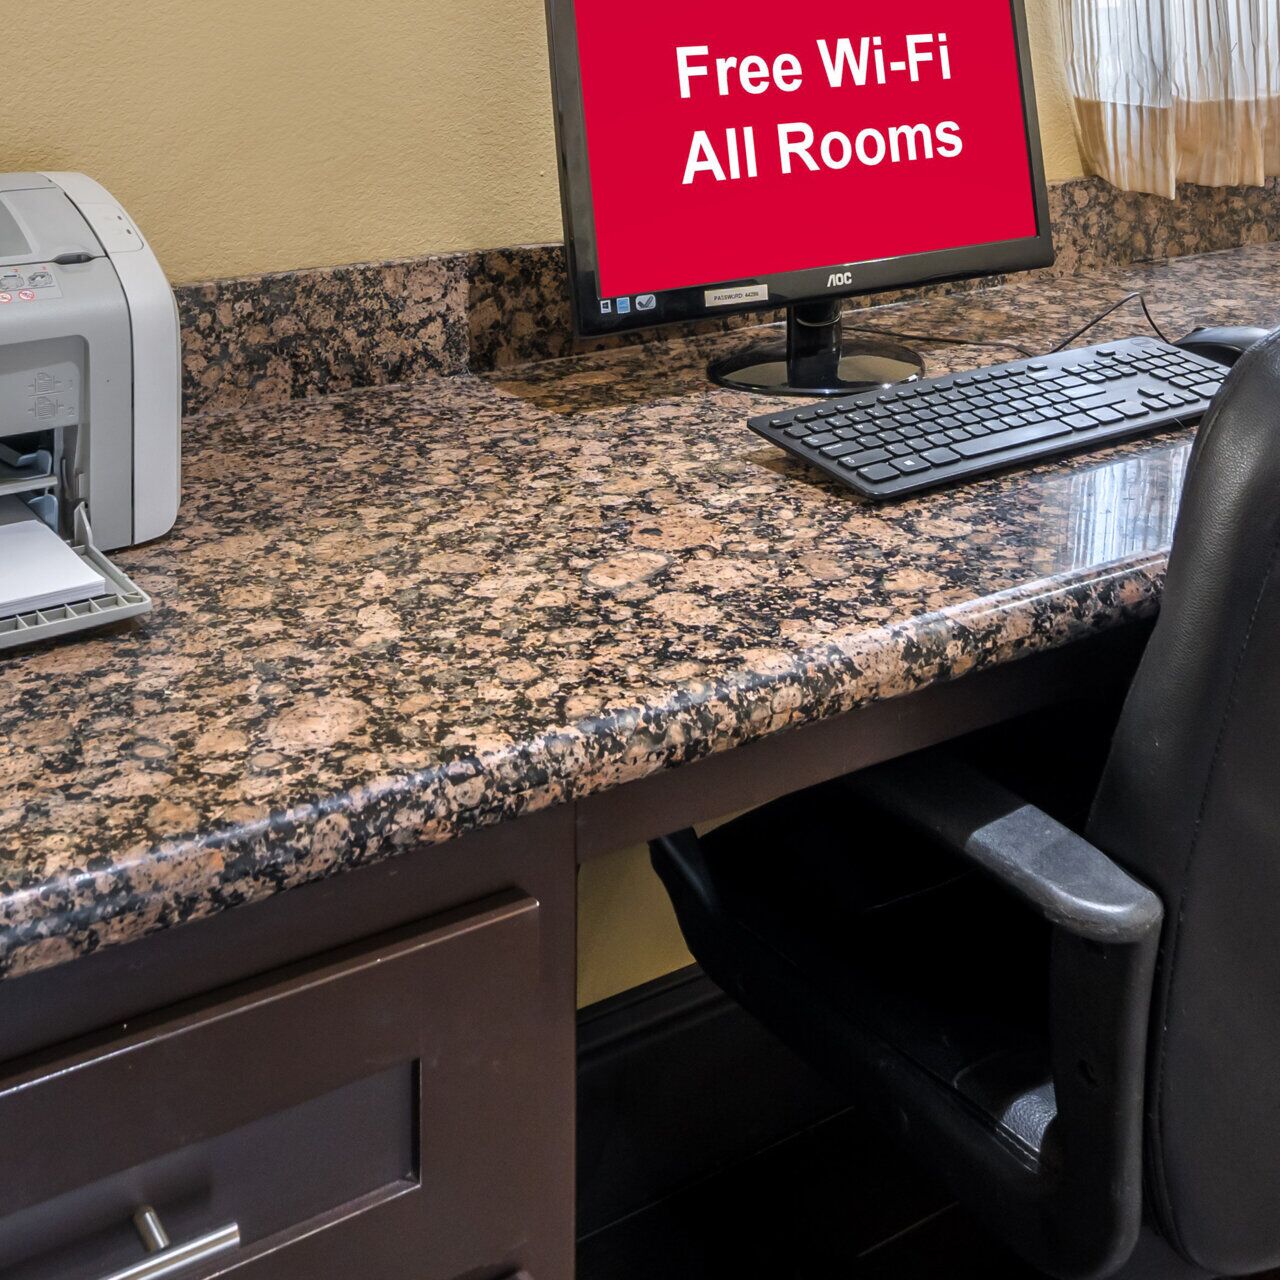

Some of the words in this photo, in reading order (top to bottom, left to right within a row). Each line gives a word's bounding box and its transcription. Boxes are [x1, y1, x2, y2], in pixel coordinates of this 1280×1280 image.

[675, 45, 803, 99] Free
[817, 32, 952, 88] Wi-Fi
[681, 126, 759, 185] All
[778, 120, 964, 174] Rooms
[827, 271, 853, 288] AOC
